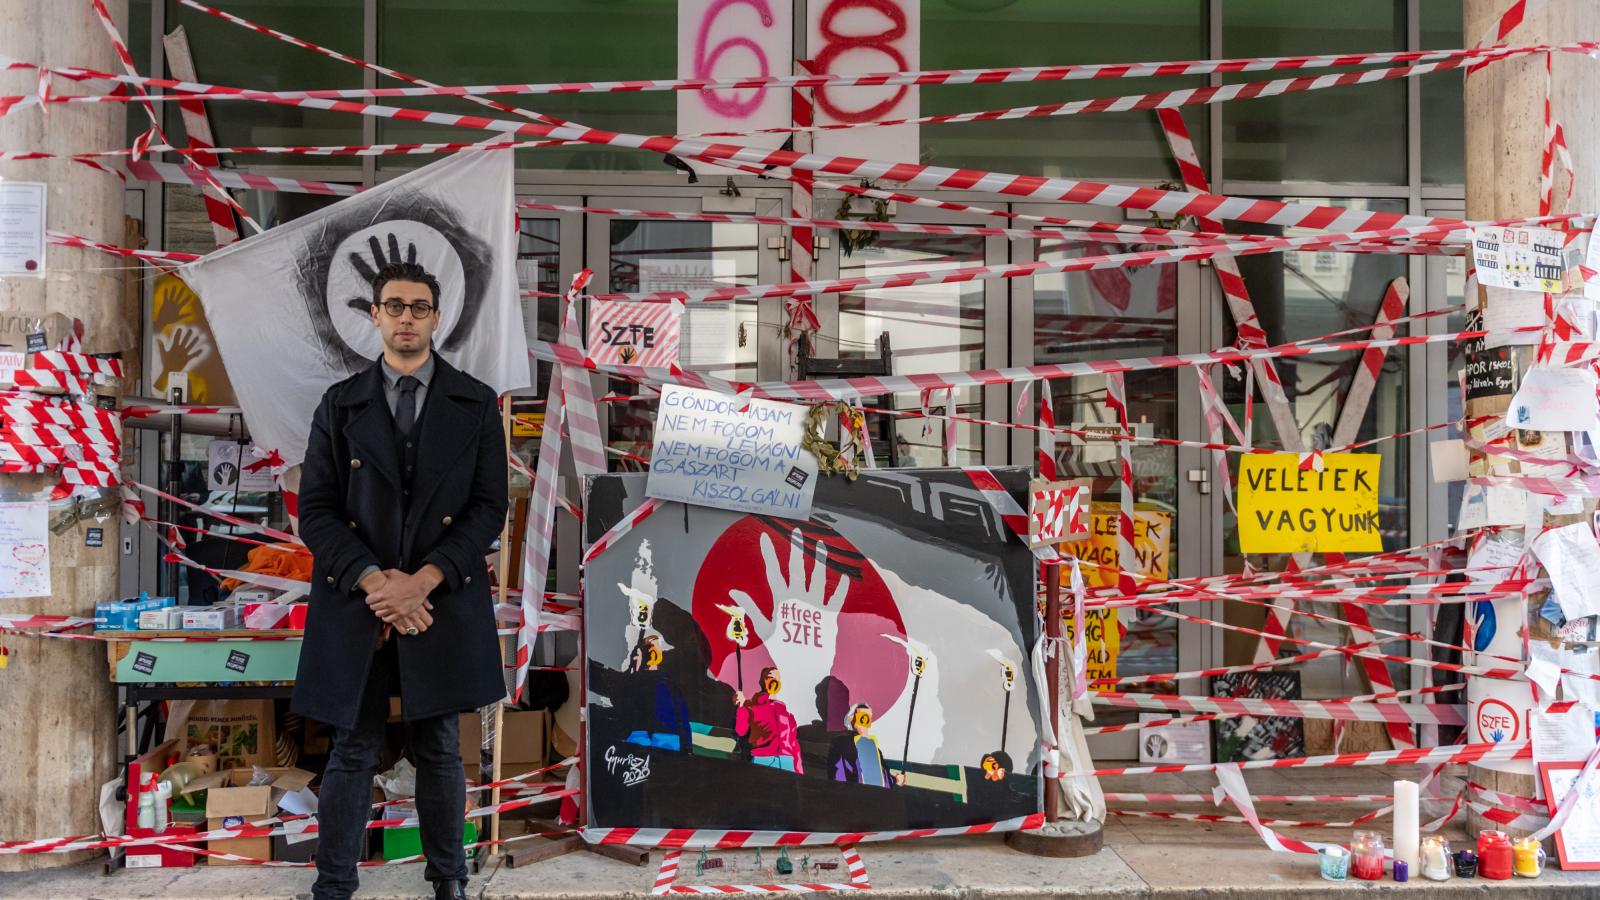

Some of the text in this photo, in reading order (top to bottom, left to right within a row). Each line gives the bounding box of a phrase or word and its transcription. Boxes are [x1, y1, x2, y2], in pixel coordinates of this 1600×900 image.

[695, 0, 773, 118] 6
[813, 0, 909, 123] 8
[601, 321, 654, 348] SZFE
[662, 413, 774, 440] NEM FOGOM
[657, 440, 785, 473] NEM FOGOM A
[1247, 467, 1372, 491] VELETEK
[1256, 507, 1381, 534] VAGYUNK
[781, 602, 822, 625] #free
[782, 621, 823, 648] SZFE
[1481, 713, 1511, 730] SZFE
[622, 766, 651, 785] 2020
